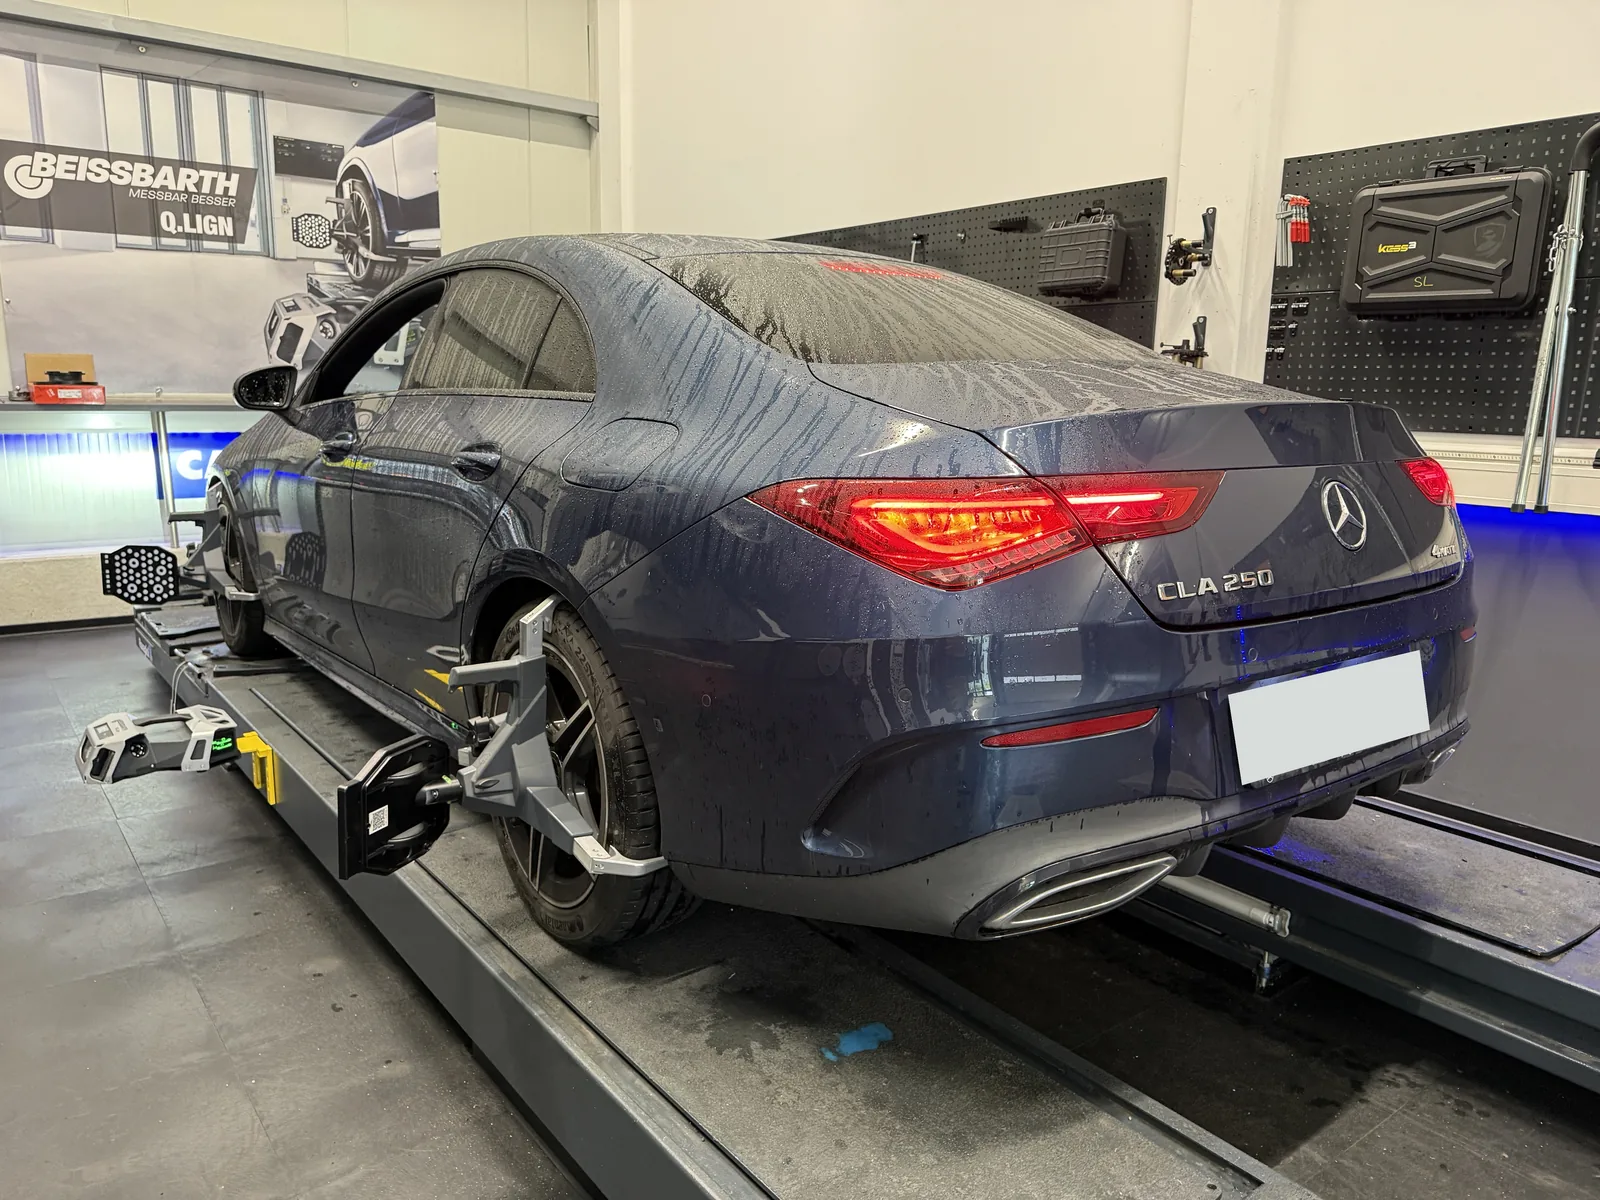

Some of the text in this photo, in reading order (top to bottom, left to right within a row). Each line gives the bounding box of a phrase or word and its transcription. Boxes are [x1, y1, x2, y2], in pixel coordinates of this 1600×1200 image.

[31, 151, 240, 196] BEISSBARTH
[128, 188, 236, 208] MESSBAR BESSER
[160, 211, 234, 236] Q.LIGN
[1414, 276, 1433, 288] SL
[1157, 569, 1274, 601] CLA 250
